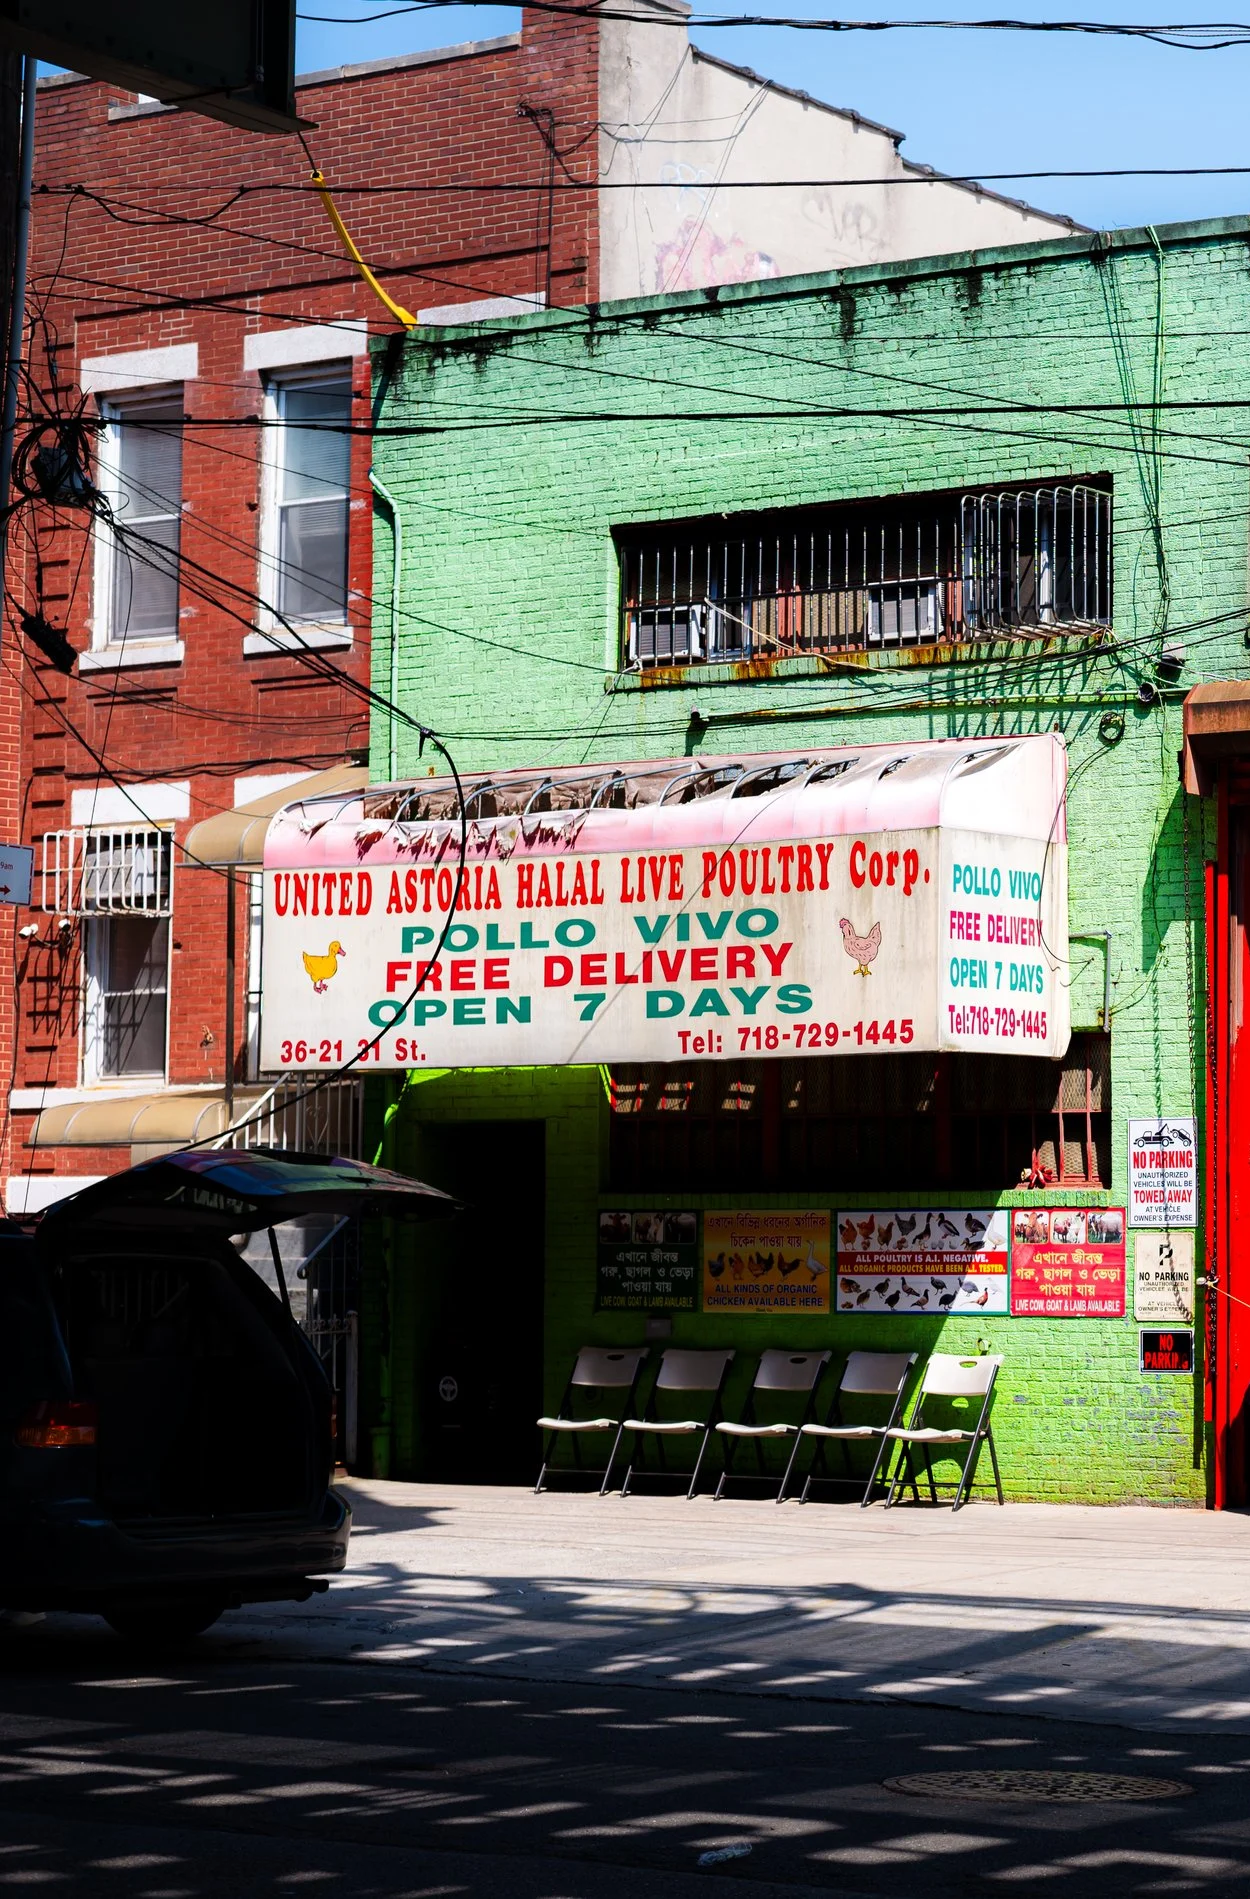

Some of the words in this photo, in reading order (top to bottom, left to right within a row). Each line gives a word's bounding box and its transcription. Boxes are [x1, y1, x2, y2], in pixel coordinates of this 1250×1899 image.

[274, 871, 373, 917] UNITED
[386, 865, 502, 914] ASTORIA
[516, 859, 605, 909] HALAL
[620, 854, 685, 904] LIVE
[702, 843, 835, 898] POULTRY
[849, 840, 930, 896] Corp.
[952, 863, 1001, 897] POLLO
[1008, 869, 1041, 901] VIVO
[401, 918, 596, 954] POLLO
[633, 907, 779, 944] VIVO
[949, 910, 980, 942] FREE
[986, 915, 1043, 947] DELIVERY
[385, 957, 510, 993] FREE
[544, 942, 794, 989] DELIVERY
[949, 957, 988, 989] OPEN
[994, 961, 1003, 990] 7
[1009, 963, 1043, 995] DAYS
[368, 996, 531, 1027] OPEN
[573, 993, 606, 1021] 7
[646, 984, 813, 1019] DAYS
[948, 1005, 1047, 1040] Tel:718-729-1445
[678, 1029, 723, 1055] Tel:
[738, 1019, 914, 1051] 718-729-1445
[280, 1040, 343, 1064] 36-21
[357, 1039, 380, 1062] 31
[395, 1037, 426, 1061] St.
[1133, 1151, 1146, 1169] NO
[1149, 1150, 1193, 1169] PARKING
[1137, 1171, 1188, 1179] UNAUTHORIZED
[1134, 1190, 1165, 1203] TOWED
[1167, 1189, 1193, 1203] AWAY
[839, 1264, 852, 1273] ALL
[853, 1264, 885, 1273] ORGANIC
[887, 1264, 924, 1273] PRODUCTS
[925, 1264, 944, 1273] HAVE
[946, 1264, 963, 1273] BEEN
[978, 1264, 1005, 1273] TESTED.
[855, 1254, 871, 1263] ALL
[874, 1254, 912, 1263] POULTRY
[915, 1254, 923, 1263] IS
[943, 1254, 988, 1263] NEGATIVE.
[1139, 1272, 1150, 1280] NO
[1155, 1272, 1189, 1280] PARKING
[715, 1284, 731, 1293] ALL
[733, 1284, 760, 1293] KINDS
[762, 1284, 774, 1293] OF
[776, 1284, 817, 1293] ORGANIC
[707, 1296, 745, 1306] CHICKEN
[747, 1296, 797, 1306] AVAILABLE
[1015, 1300, 1028, 1311] LIVE
[1046, 1300, 1062, 1311] GOAT
[1069, 1300, 1086, 1311] LAMB
[1087, 1300, 1120, 1311] AVAILABLE
[1159, 1334, 1174, 1351] NO
